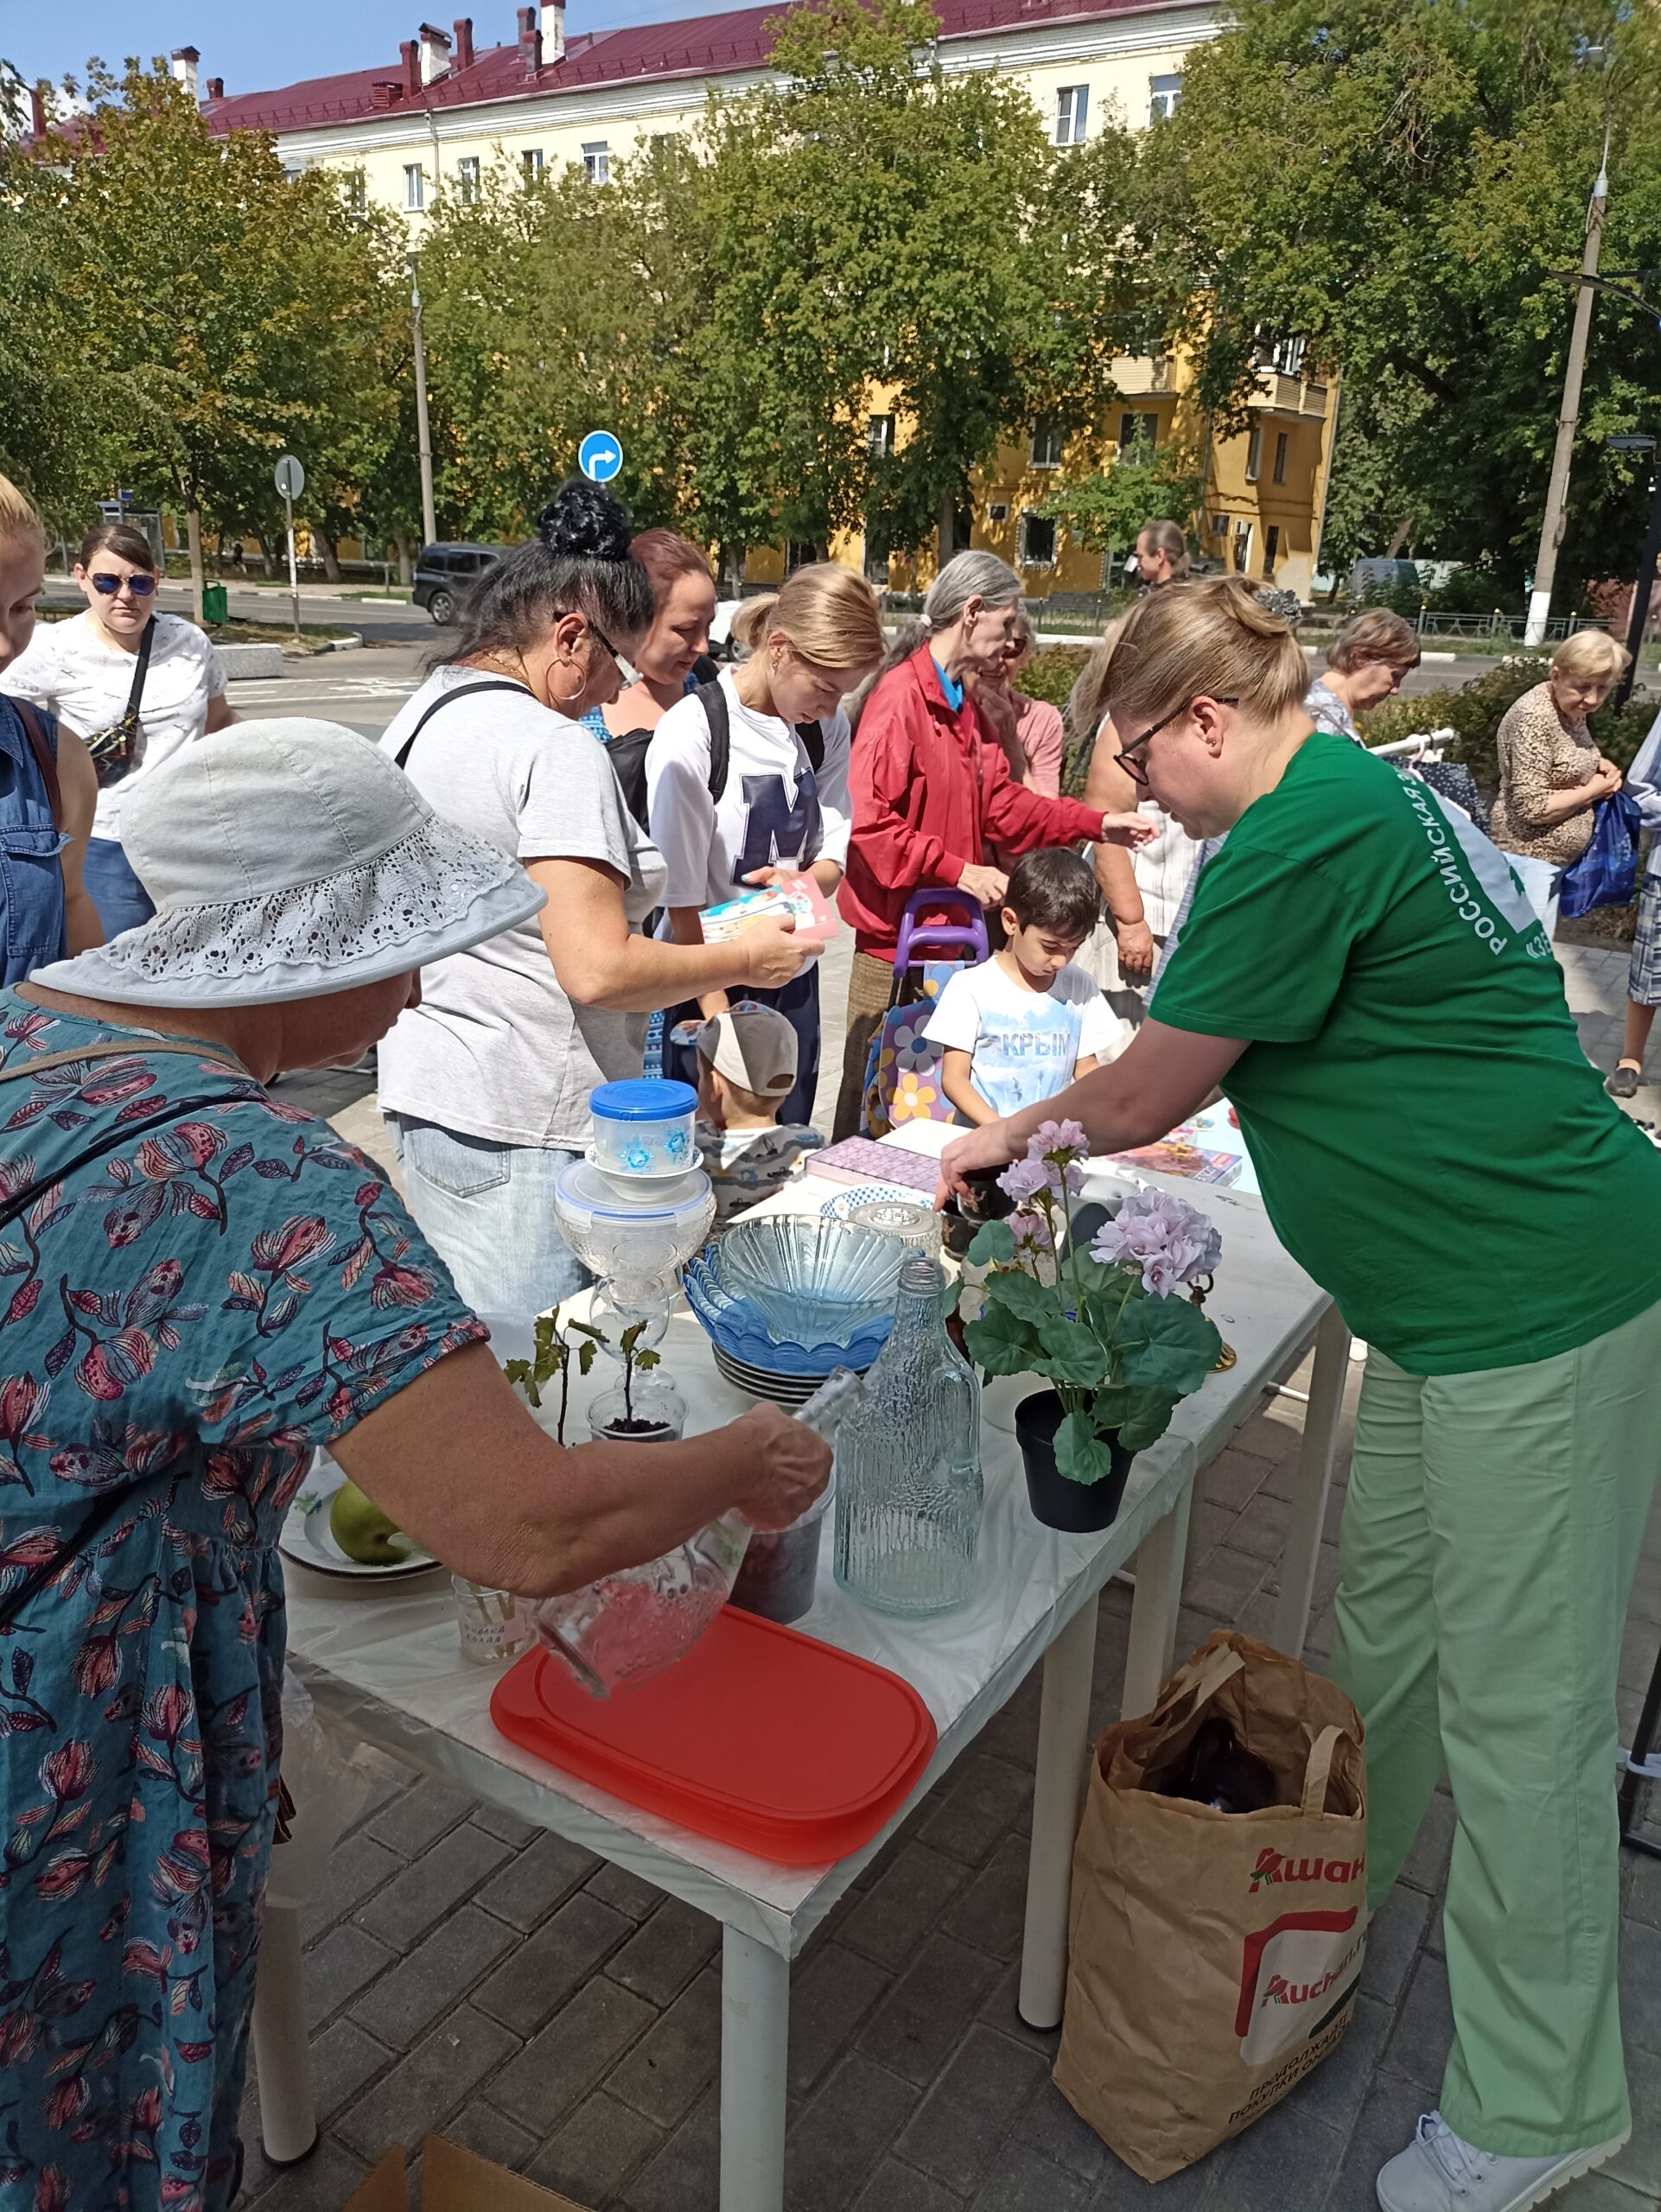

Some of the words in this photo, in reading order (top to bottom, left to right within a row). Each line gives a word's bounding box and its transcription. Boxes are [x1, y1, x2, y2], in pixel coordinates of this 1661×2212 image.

[1403, 786, 1507, 955] РОССИЙСКАЯ
[1002, 1033, 1071, 1056] КРЫМ
[1248, 1847, 1365, 1893] Ашан
[1228, 2067, 1300, 2123] ПОКУПКИ
